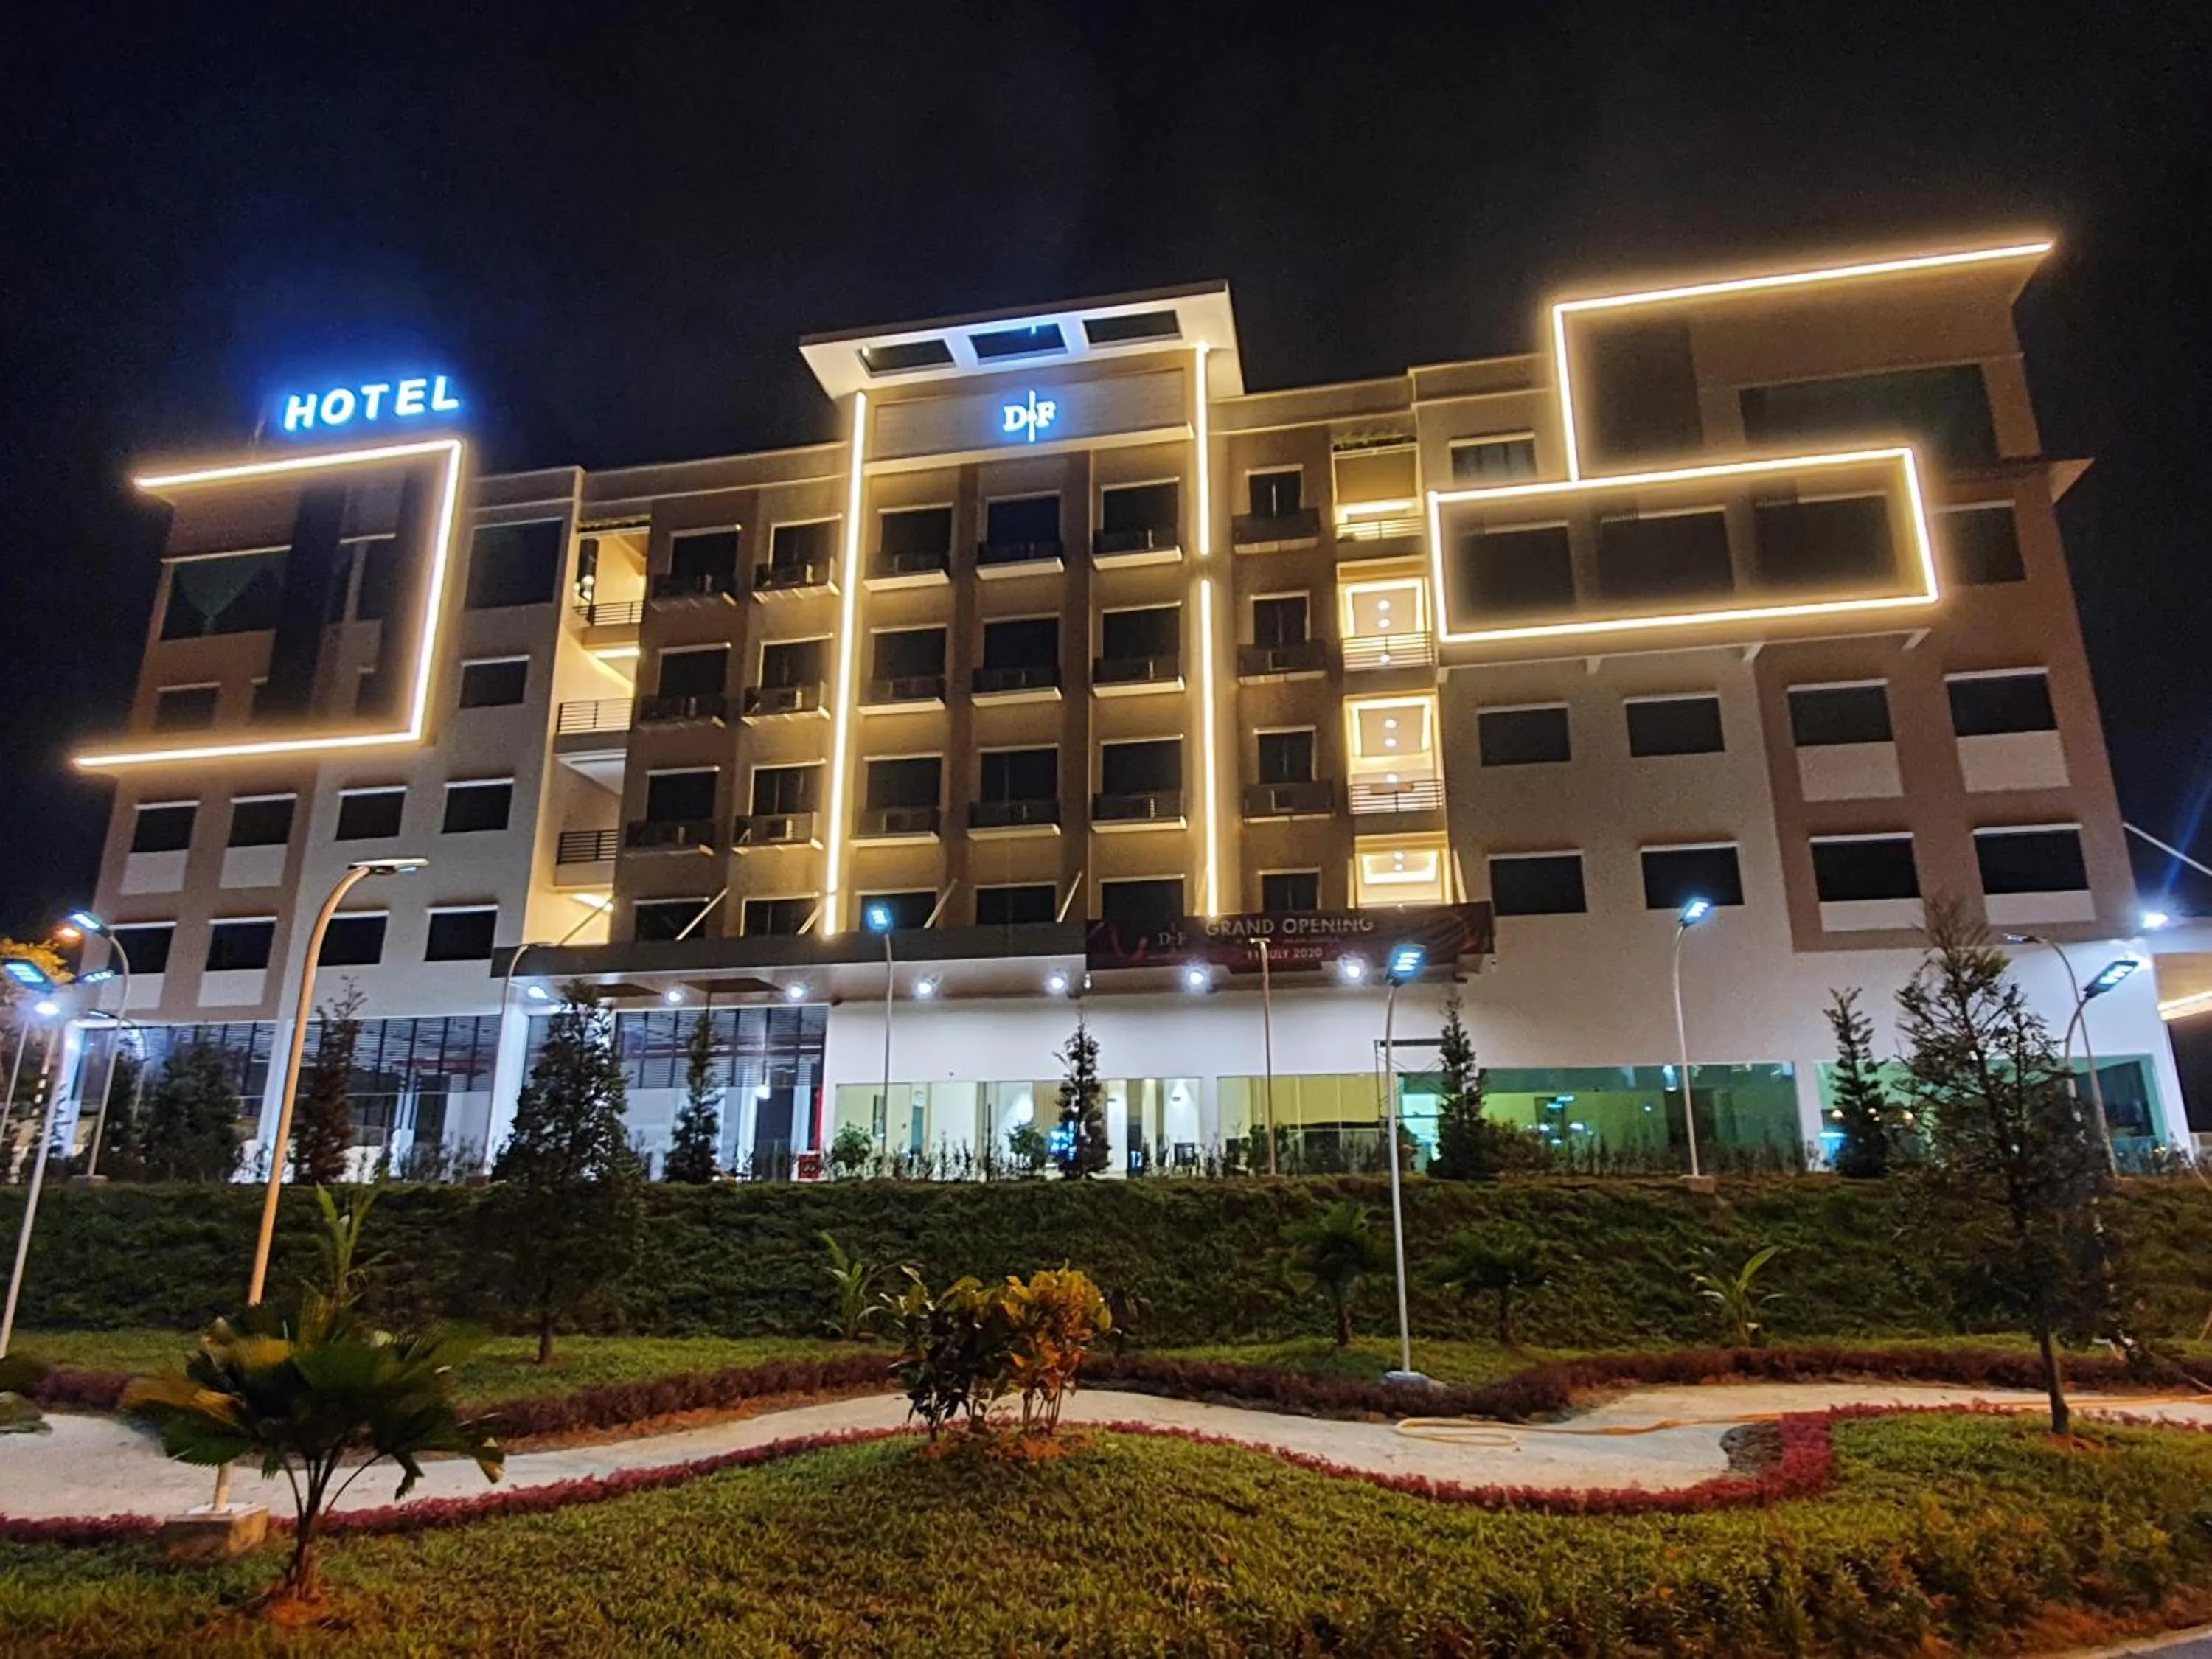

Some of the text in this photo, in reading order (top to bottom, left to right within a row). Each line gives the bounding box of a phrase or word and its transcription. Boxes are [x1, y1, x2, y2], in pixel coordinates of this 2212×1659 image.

[283, 375, 459, 431] HOTEL
[1205, 917, 1374, 936] GRAND OPENING
[1269, 949, 1290, 959] ULY
[1293, 947, 1324, 959] 2020
